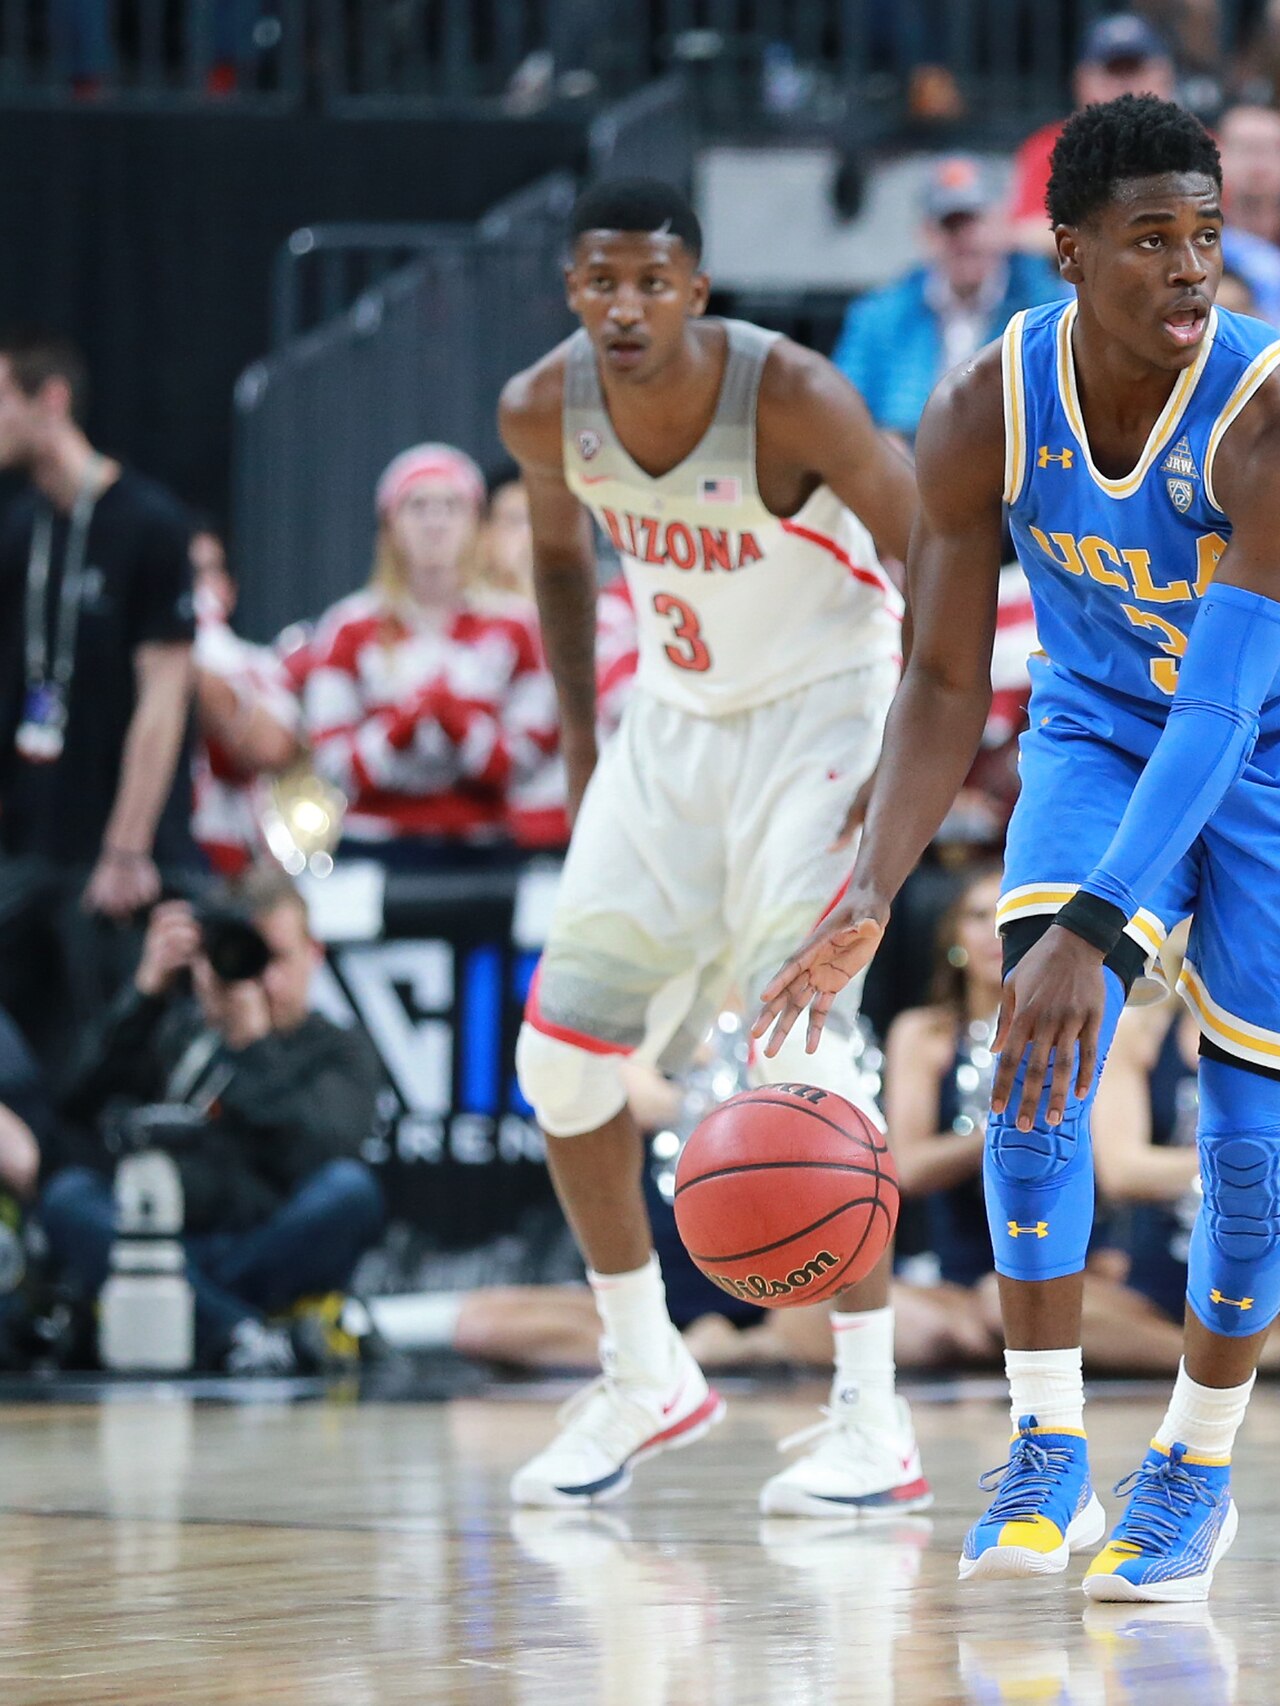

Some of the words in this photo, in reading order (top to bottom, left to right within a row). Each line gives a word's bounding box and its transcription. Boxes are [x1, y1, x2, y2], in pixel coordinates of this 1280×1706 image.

[1166, 456, 1192, 474] JRW
[1169, 480, 1191, 500] PAC
[1174, 493, 1187, 507] 12
[1029, 531, 1228, 603] UCLA
[653, 593, 712, 672] 3
[1120, 603, 1189, 695] 3
